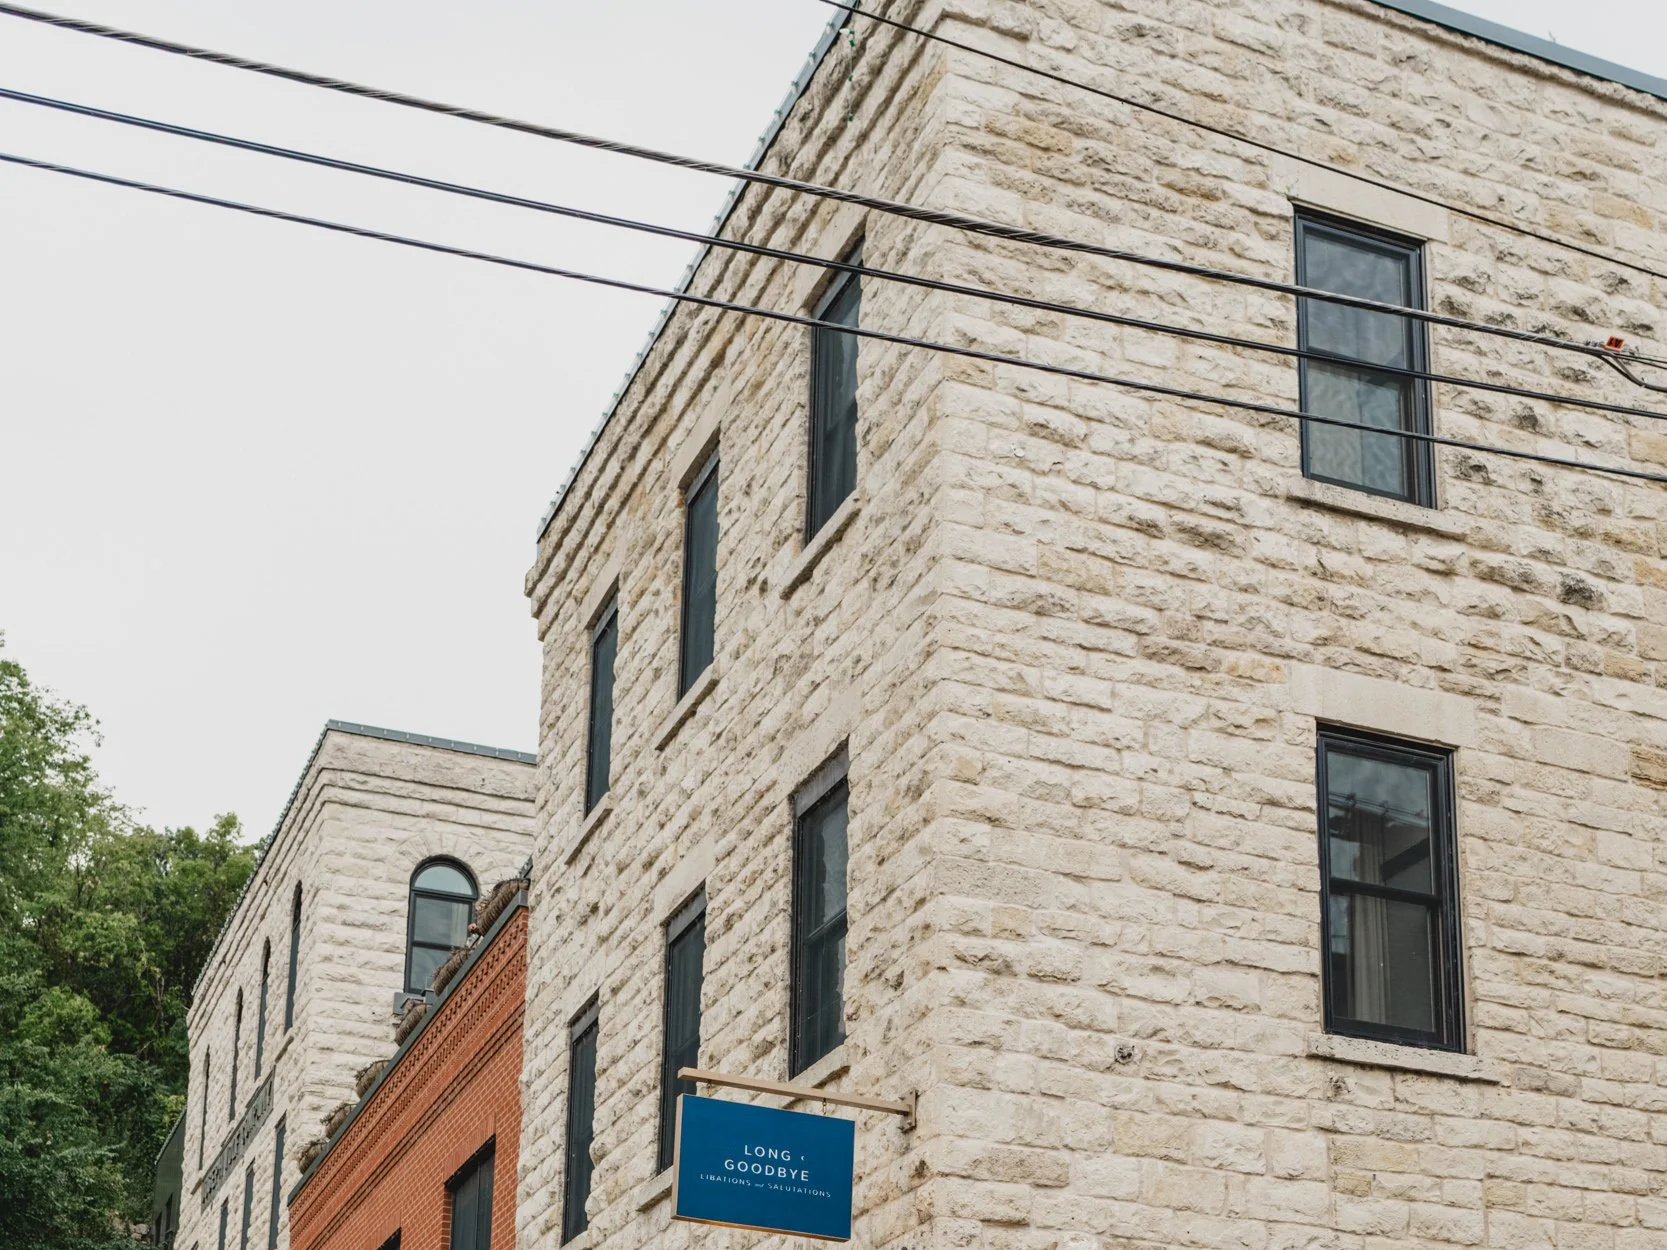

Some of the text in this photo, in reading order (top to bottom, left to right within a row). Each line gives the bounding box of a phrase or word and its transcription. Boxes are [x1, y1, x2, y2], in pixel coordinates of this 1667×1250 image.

[744, 1144, 791, 1161] LONG
[724, 1159, 809, 1182] GOODBYE
[700, 1173, 751, 1186] LIBATIONS
[767, 1183, 831, 1198] SALUTATIONS
